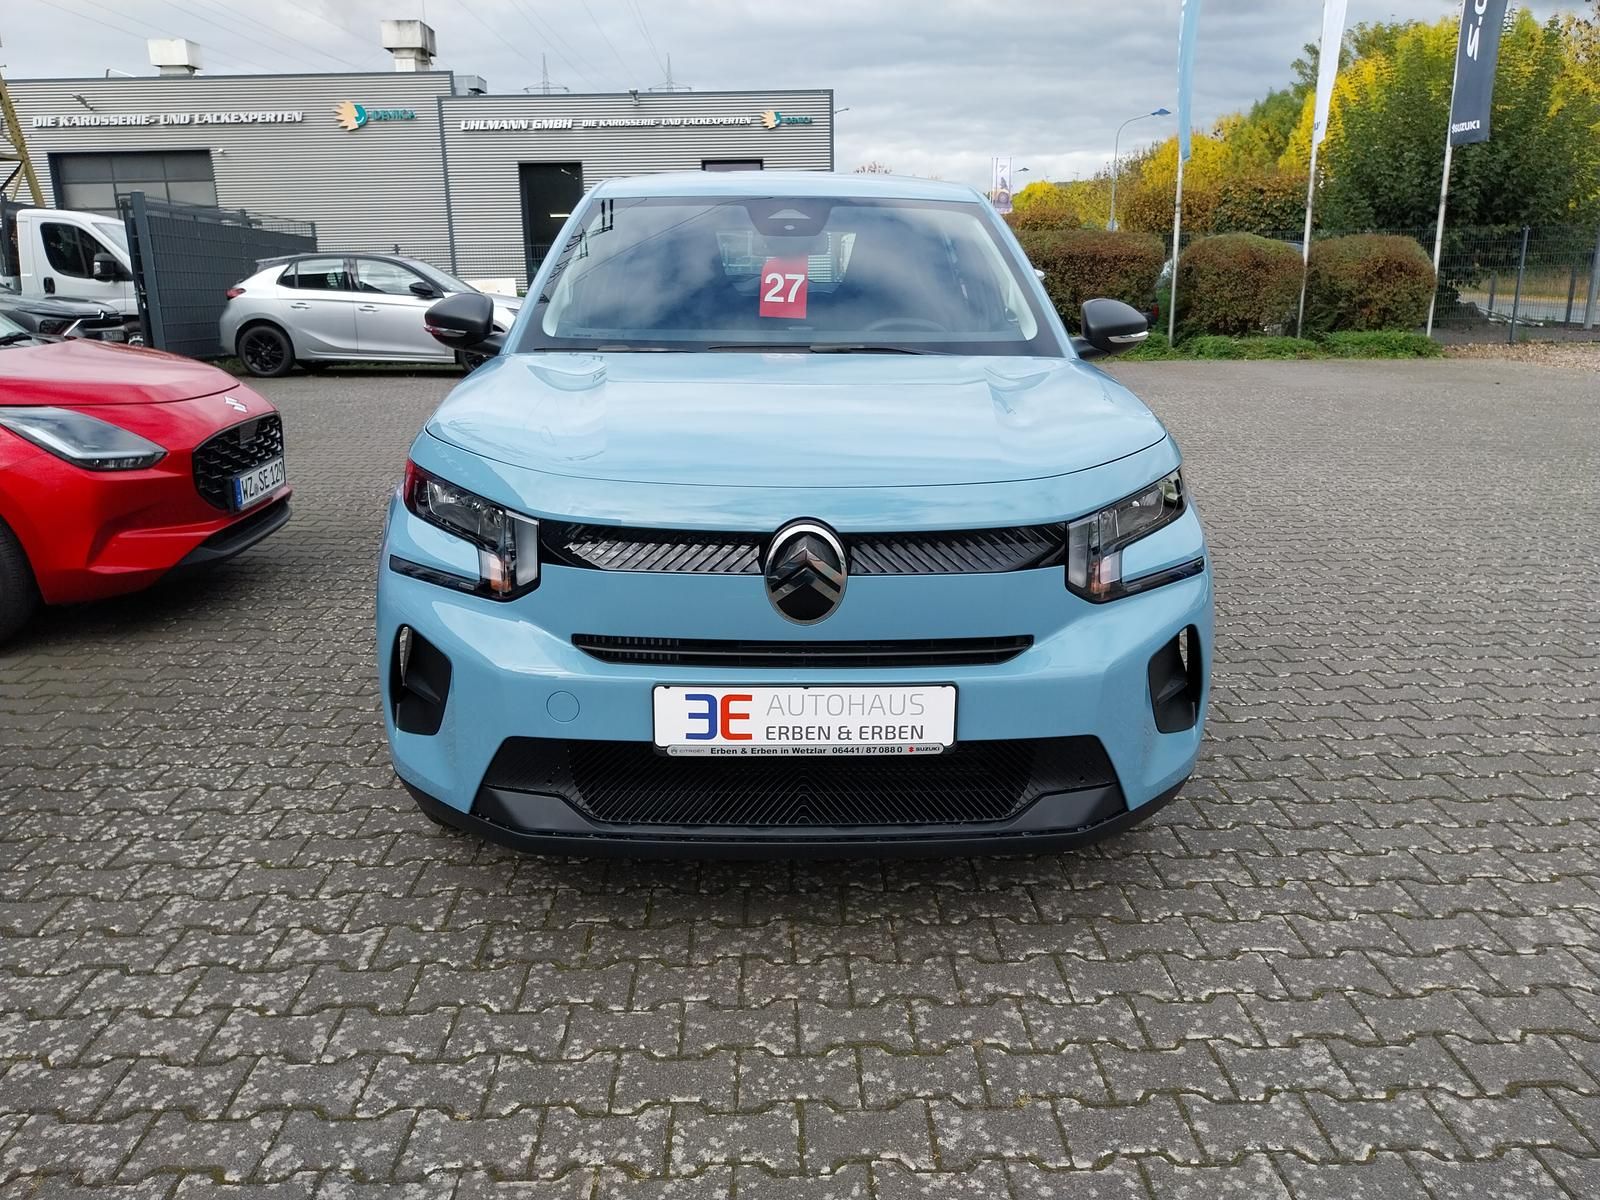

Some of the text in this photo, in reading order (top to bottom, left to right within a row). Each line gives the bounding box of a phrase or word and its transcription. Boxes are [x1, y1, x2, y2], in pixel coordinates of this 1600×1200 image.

[32, 111, 303, 128] DIE KAROSSERIE- UND LACKEXPERTEN
[460, 116, 752, 131] UHLMANN GMBH DIE KAROSSERIE- UND LACKEXPERTEN
[1455, 120, 1480, 132] SUZUKI
[764, 272, 805, 303] 27
[241, 476, 254, 500] WZ
[766, 693, 925, 717] AUTOHAUS
[765, 724, 924, 741] ERBEN & ERBEN
[710, 747, 738, 755] Erben
[740, 747, 748, 755] &
[751, 747, 778, 755] Erben
[781, 747, 789, 755] in
[792, 746, 826, 755] Wetzlar
